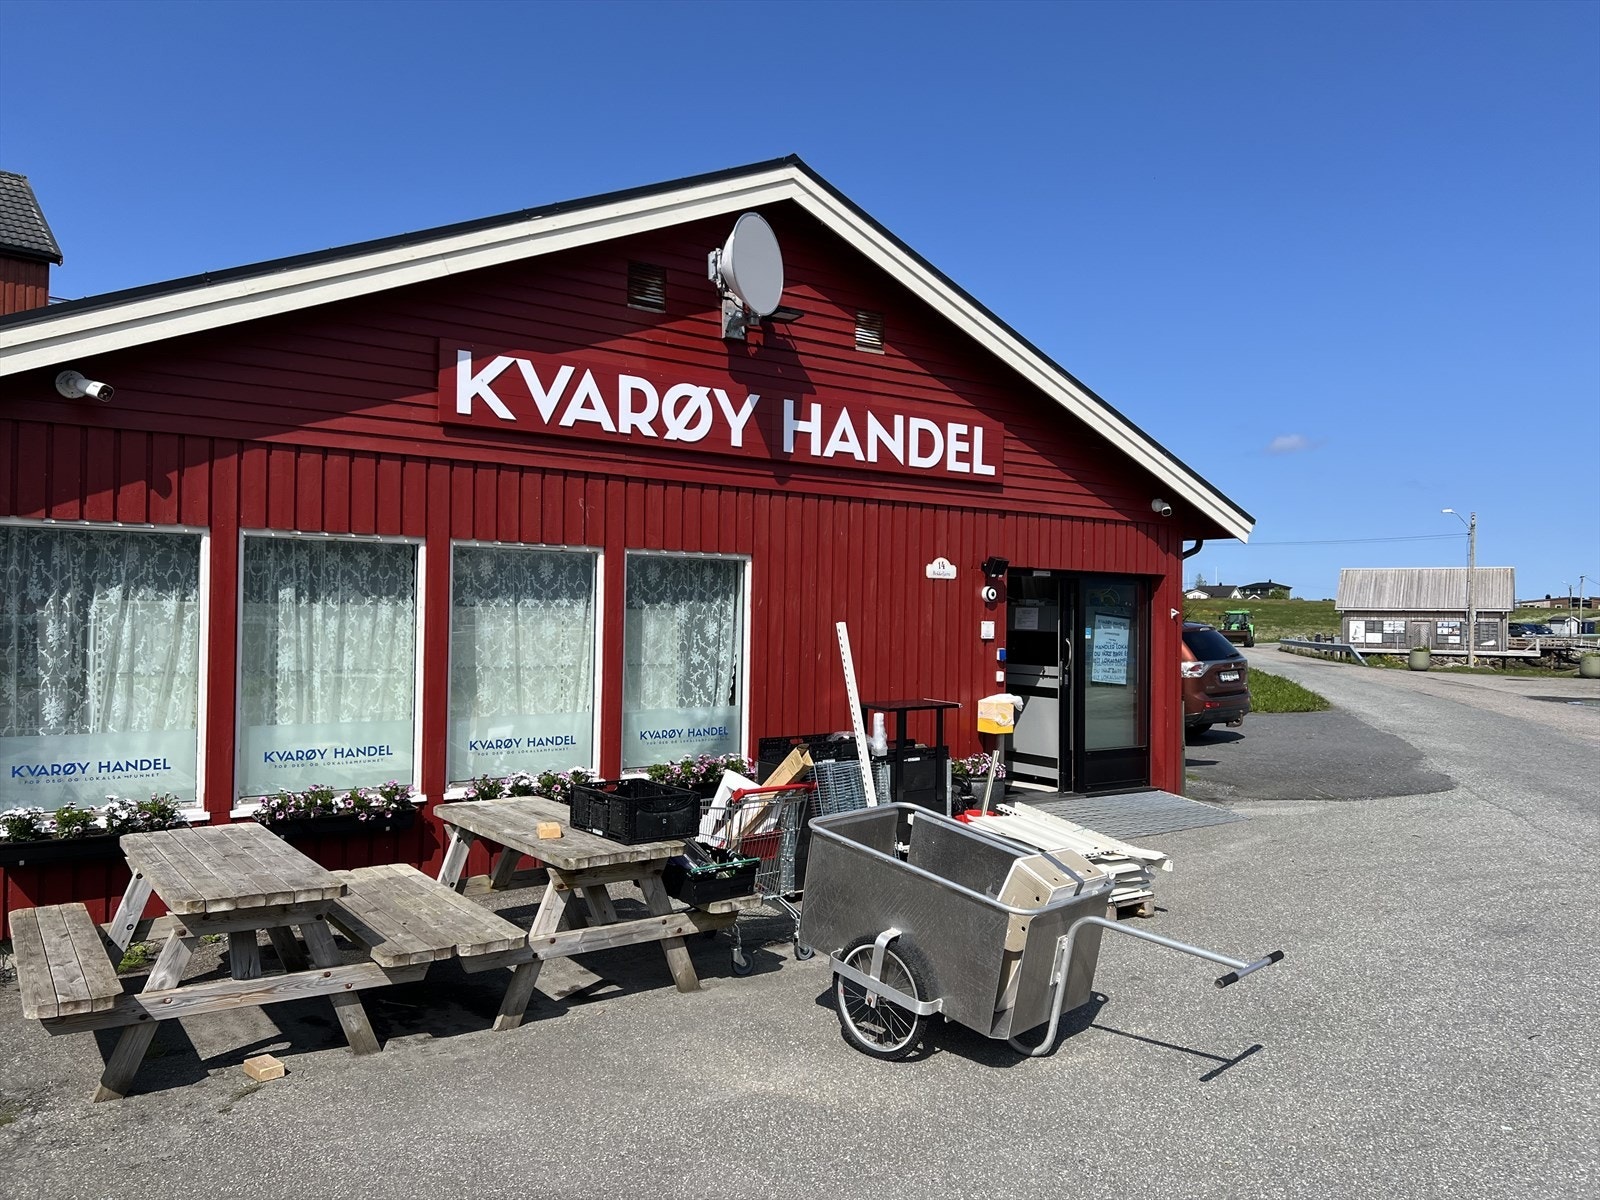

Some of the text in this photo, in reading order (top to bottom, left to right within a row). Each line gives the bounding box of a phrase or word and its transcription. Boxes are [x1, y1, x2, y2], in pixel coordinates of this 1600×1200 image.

[456, 349, 996, 476] KVARØY HANDEL
[938, 561, 946, 570] 14
[639, 726, 729, 740] KVARØY HANDEL
[469, 735, 577, 751] KVARØY HANDEL
[264, 745, 393, 763] KVARØY HANDEL
[11, 758, 171, 778] KVARØY HANDEL
